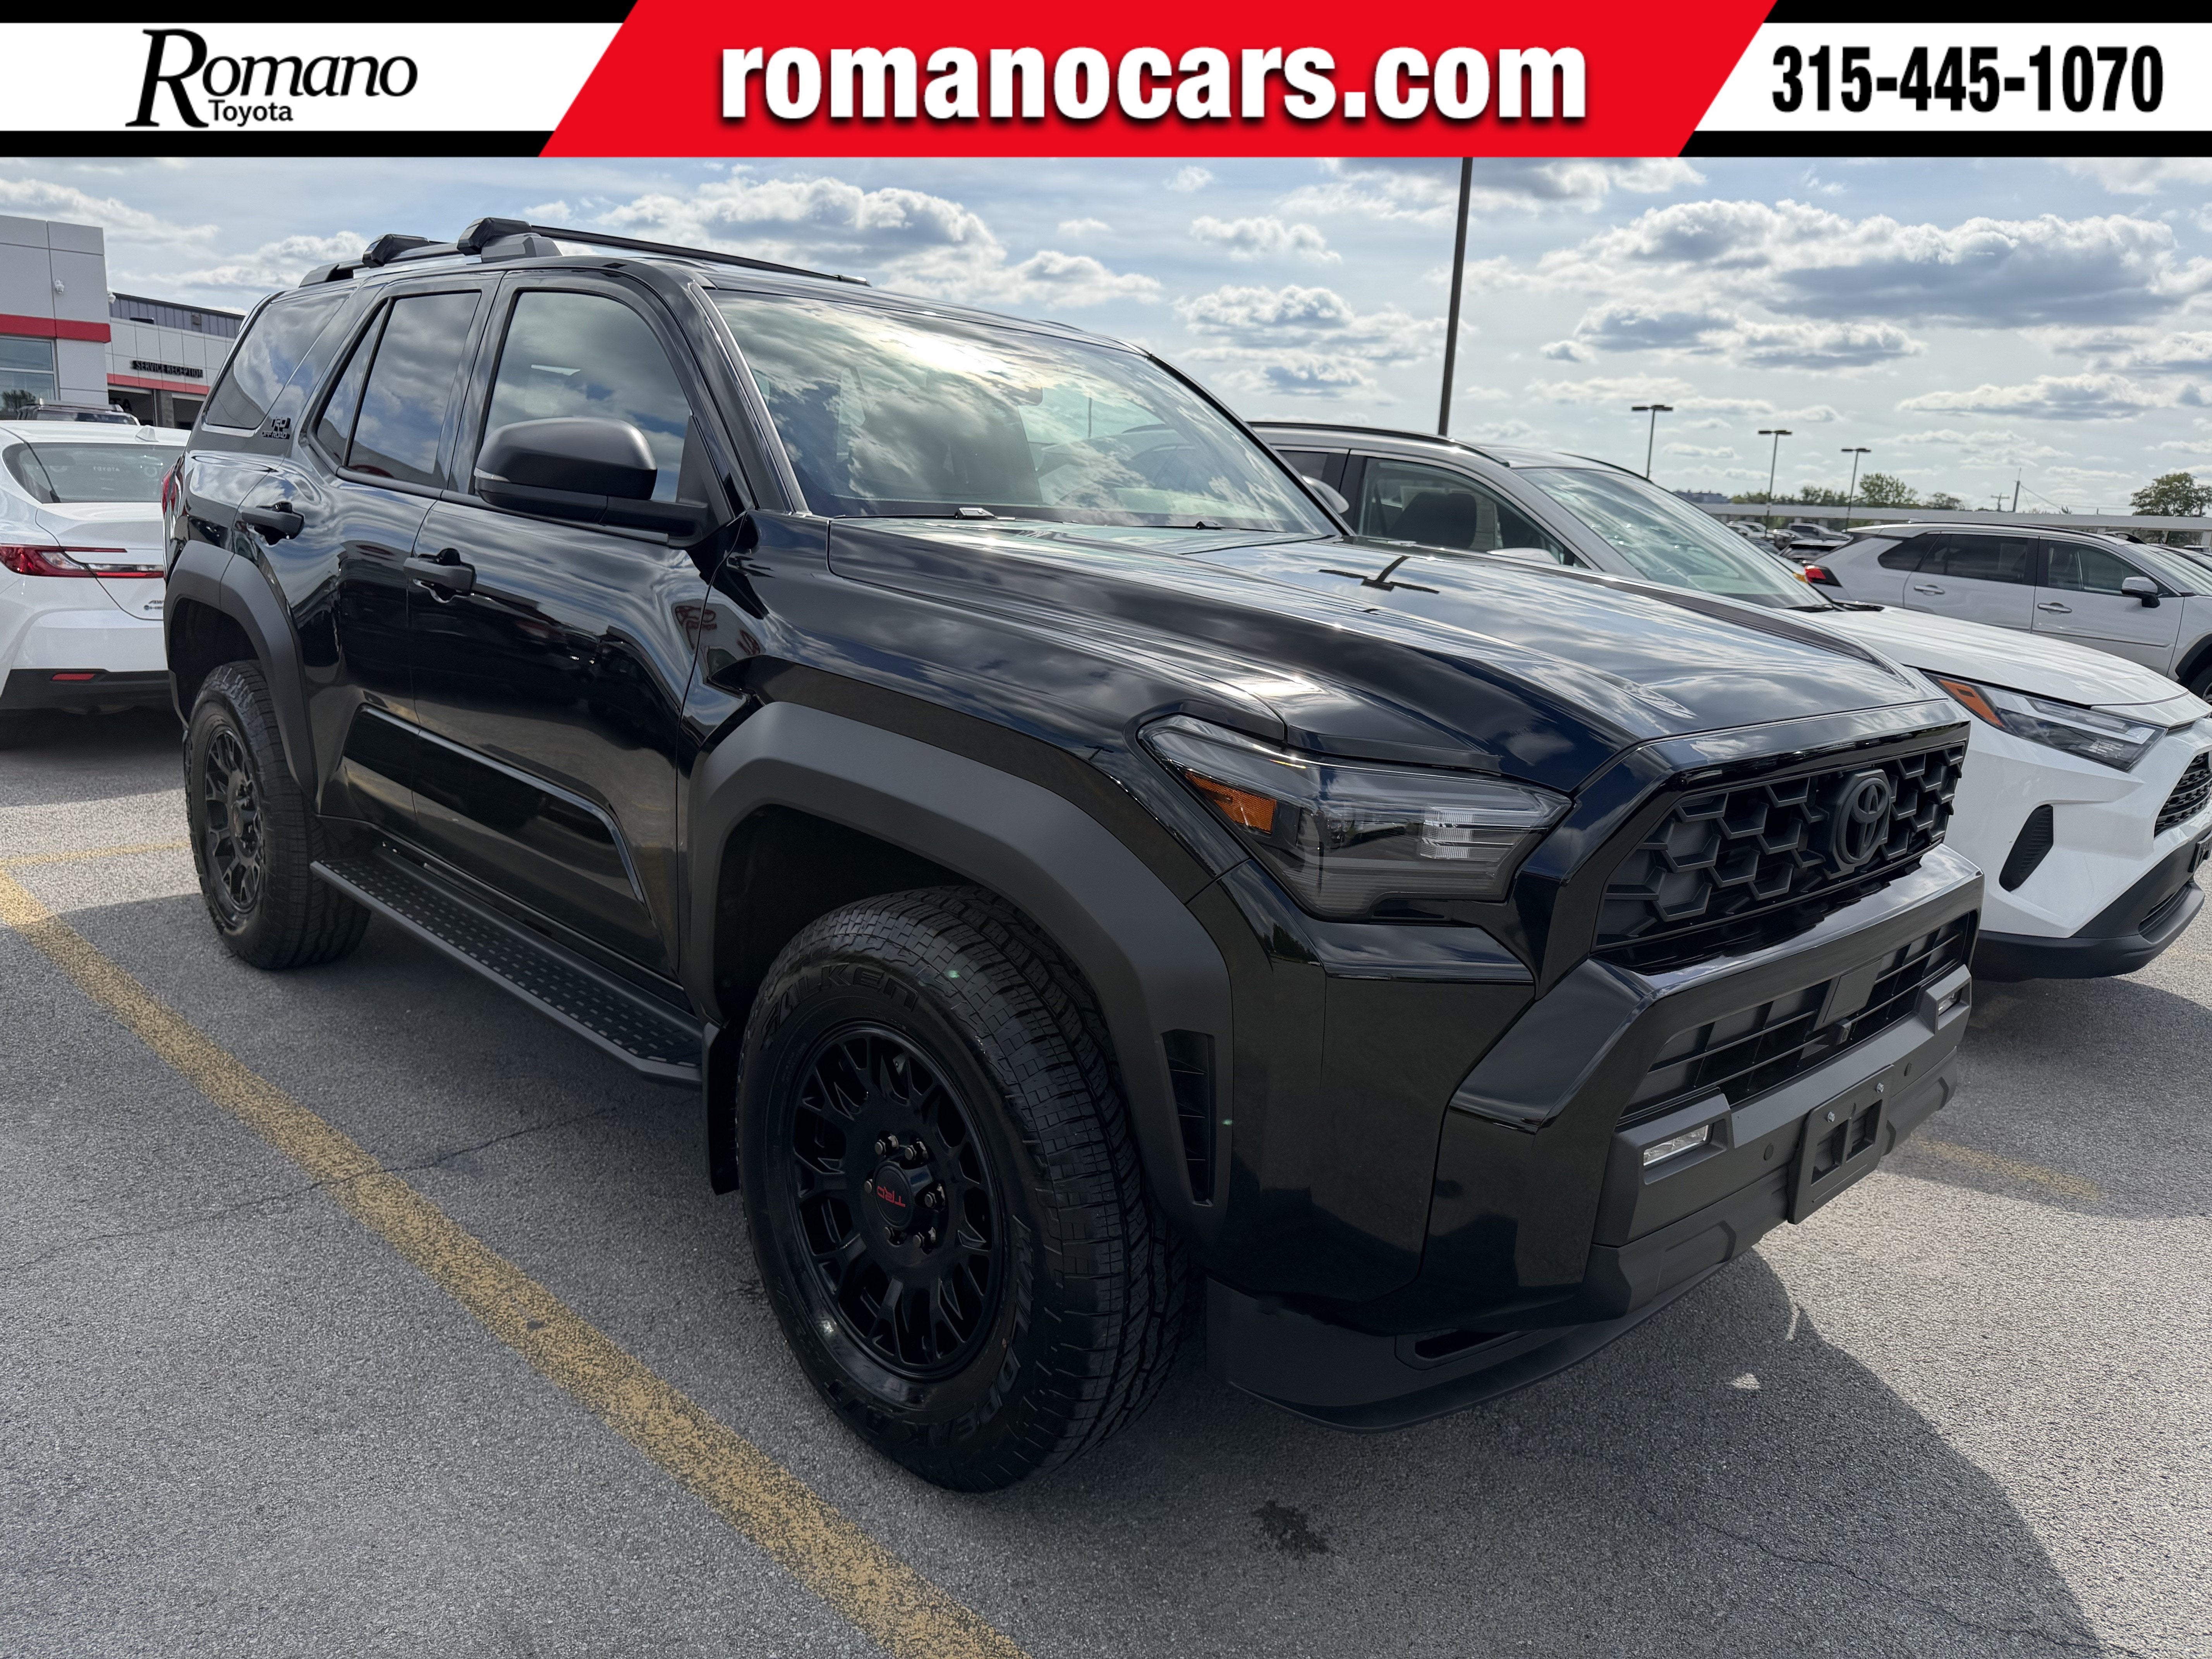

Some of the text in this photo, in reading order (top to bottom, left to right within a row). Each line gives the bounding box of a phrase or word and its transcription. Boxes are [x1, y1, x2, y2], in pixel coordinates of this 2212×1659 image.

[132, 360, 203, 378] SERVICE RECEPTION
[877, 1185, 906, 1208] TRD
